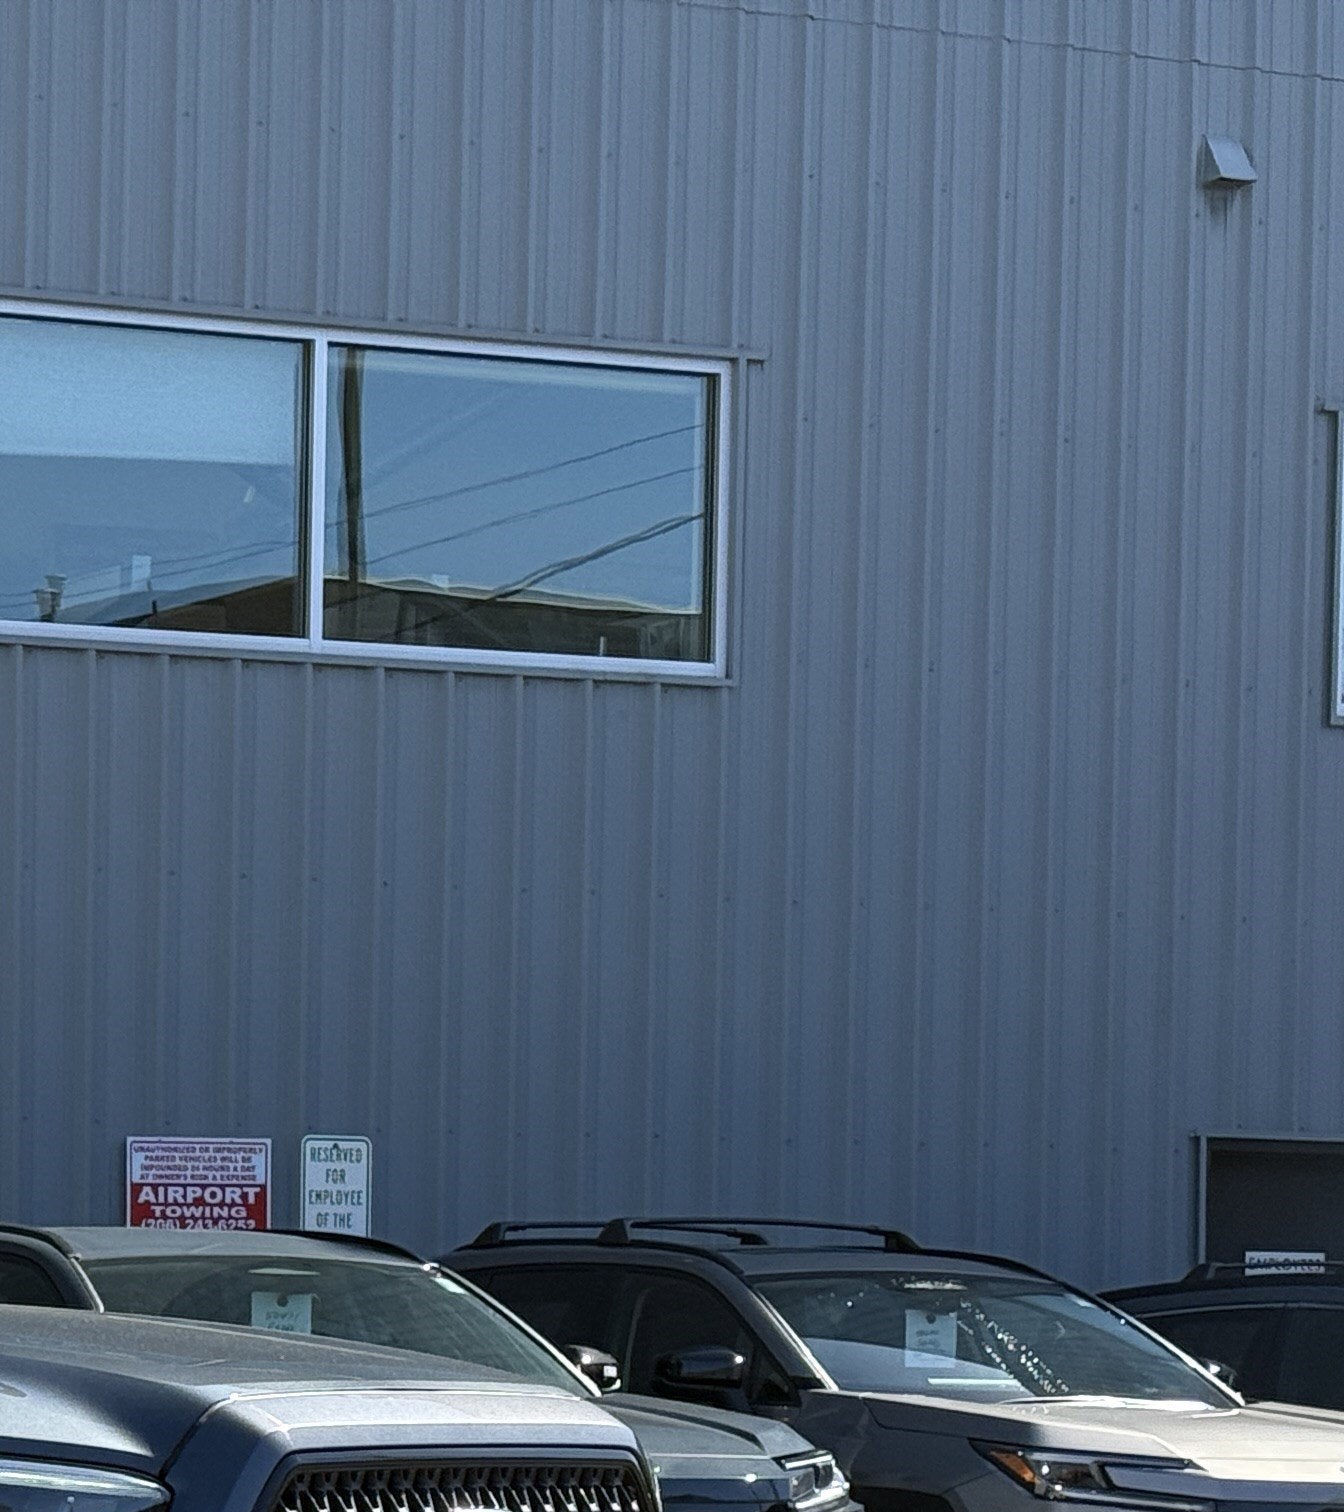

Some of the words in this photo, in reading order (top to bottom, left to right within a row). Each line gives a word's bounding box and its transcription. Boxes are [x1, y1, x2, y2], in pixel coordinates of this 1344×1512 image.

[310, 1146, 363, 1164] RESERVED
[325, 1168, 346, 1185] FOR
[137, 1185, 261, 1205] AIRPORT
[308, 1188, 364, 1206] EMPLOYEE
[150, 1205, 248, 1218] TOWING
[316, 1212, 330, 1229] OF
[332, 1212, 353, 1230] THE
